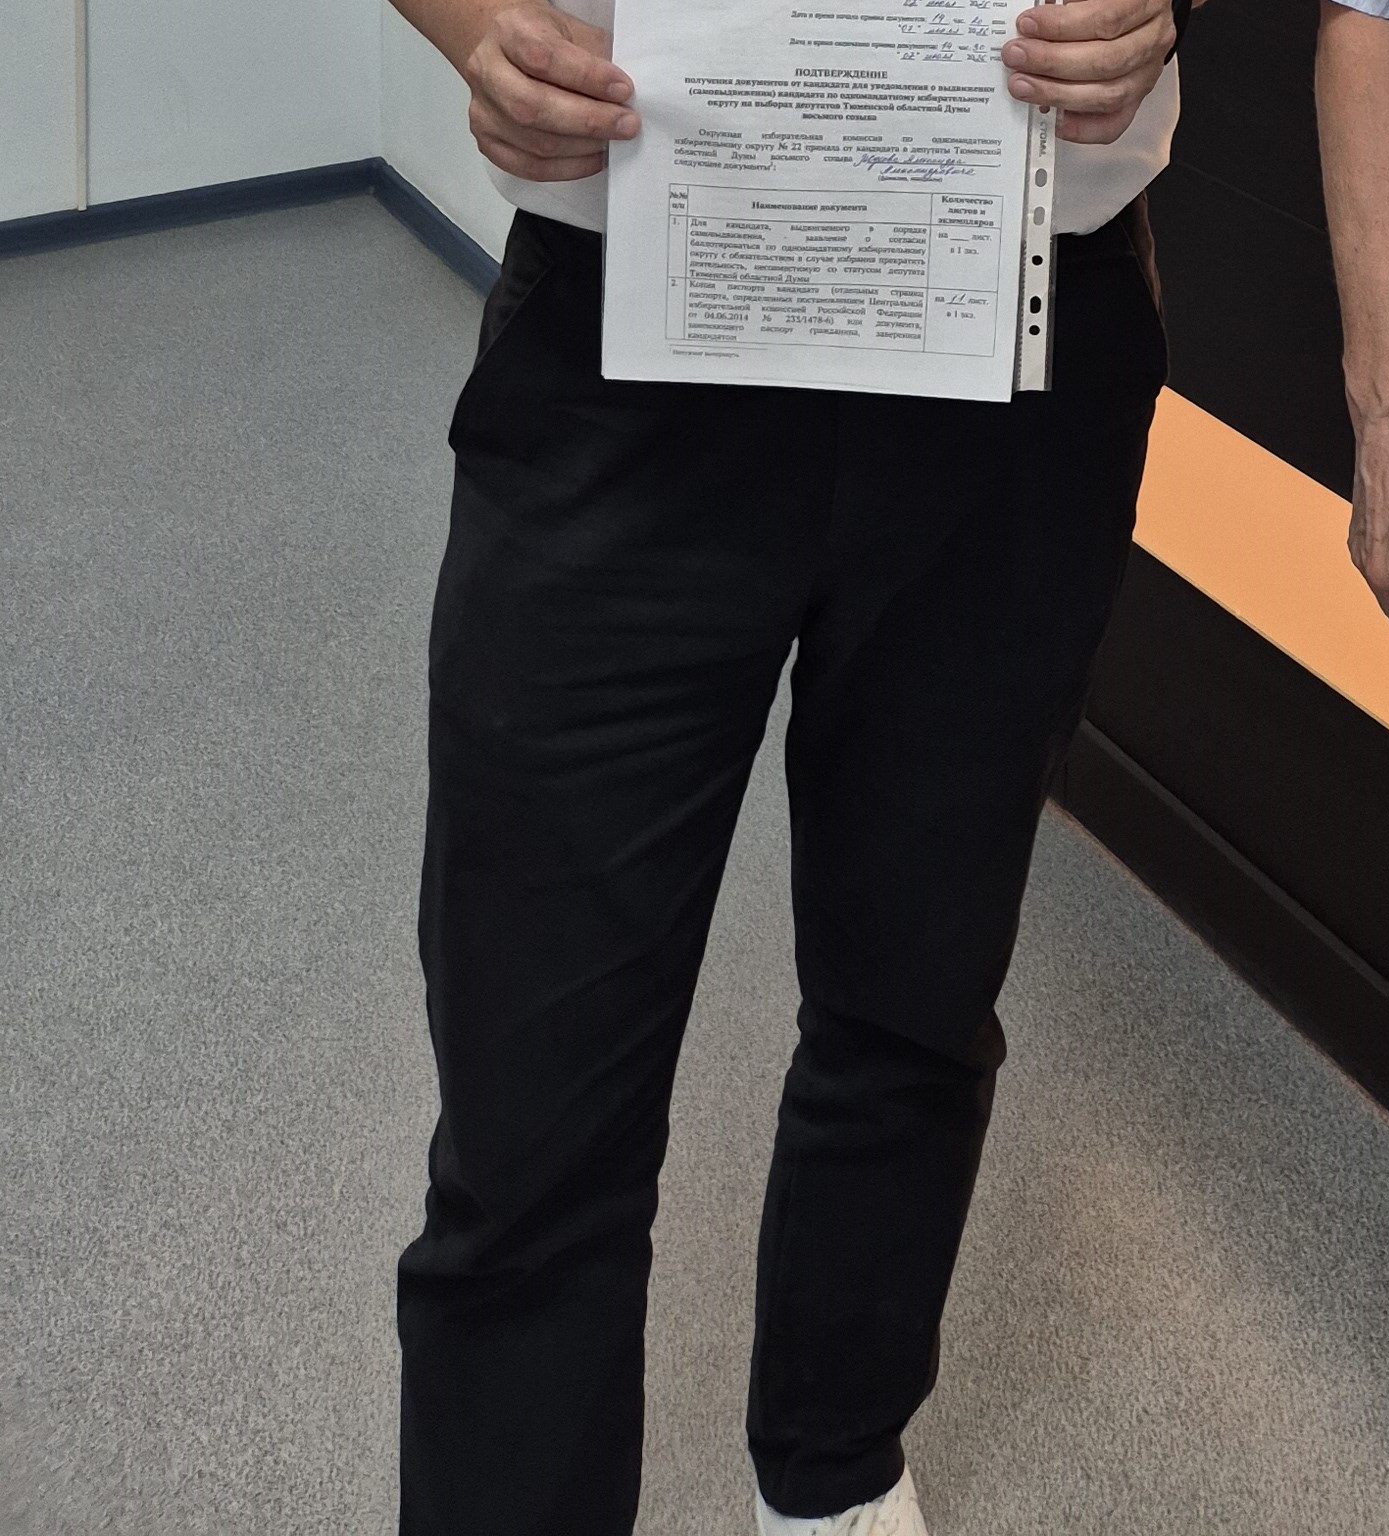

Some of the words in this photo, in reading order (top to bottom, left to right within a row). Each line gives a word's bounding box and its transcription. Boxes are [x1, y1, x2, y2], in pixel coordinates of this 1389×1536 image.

[791, 10, 807, 18] Дата
[789, 37, 806, 45] Дата
[795, 67, 888, 79] ПОДТВЕРЖДЕНИЕ
[684, 76, 733, 86] получения
[734, 78, 788, 87] документов
[803, 81, 850, 89] кандидата
[852, 82, 868, 90] для
[870, 83, 928, 92] уведомления
[938, 85, 995, 93] выдвижении
[689, 88, 776, 99] (самовыдвижении)
[778, 90, 825, 99] кандидата
[840, 92, 915, 102] одномандатному
[917, 94, 989, 104] избирательному
[707, 99, 738, 109] округу
[755, 100, 793, 109] выборах
[795, 102, 841, 111] депутатов
[843, 102, 894, 111] Тюменской
[896, 103, 942, 112] областной
[944, 104, 971, 114] Думы
[698, 128, 742, 139] Окружная
[761, 131, 823, 141] избирательная
[932, 136, 1002, 146] одномандатному
[674, 138, 742, 150] избирательному
[745, 142, 774, 152] округу
[856, 145, 899, 153] кандидата
[910, 147, 950, 155] депутаты
[953, 146, 1002, 155] Тюменской
[674, 148, 718, 158] областной
[731, 150, 756, 161] Думы
[770, 154, 810, 162] восьмого
[824, 155, 853, 163] созыва
[674, 158, 722, 168] следующие
[669, 191, 688, 199] №№
[941, 195, 994, 206] Количество
[752, 200, 817, 211] Наименование
[819, 204, 867, 213] документа
[690, 218, 707, 227] Для
[690, 250, 718, 260] округу
[740, 272, 783, 282] областной
[784, 274, 810, 284] Думы
[727, 284, 766, 293] паспорта
